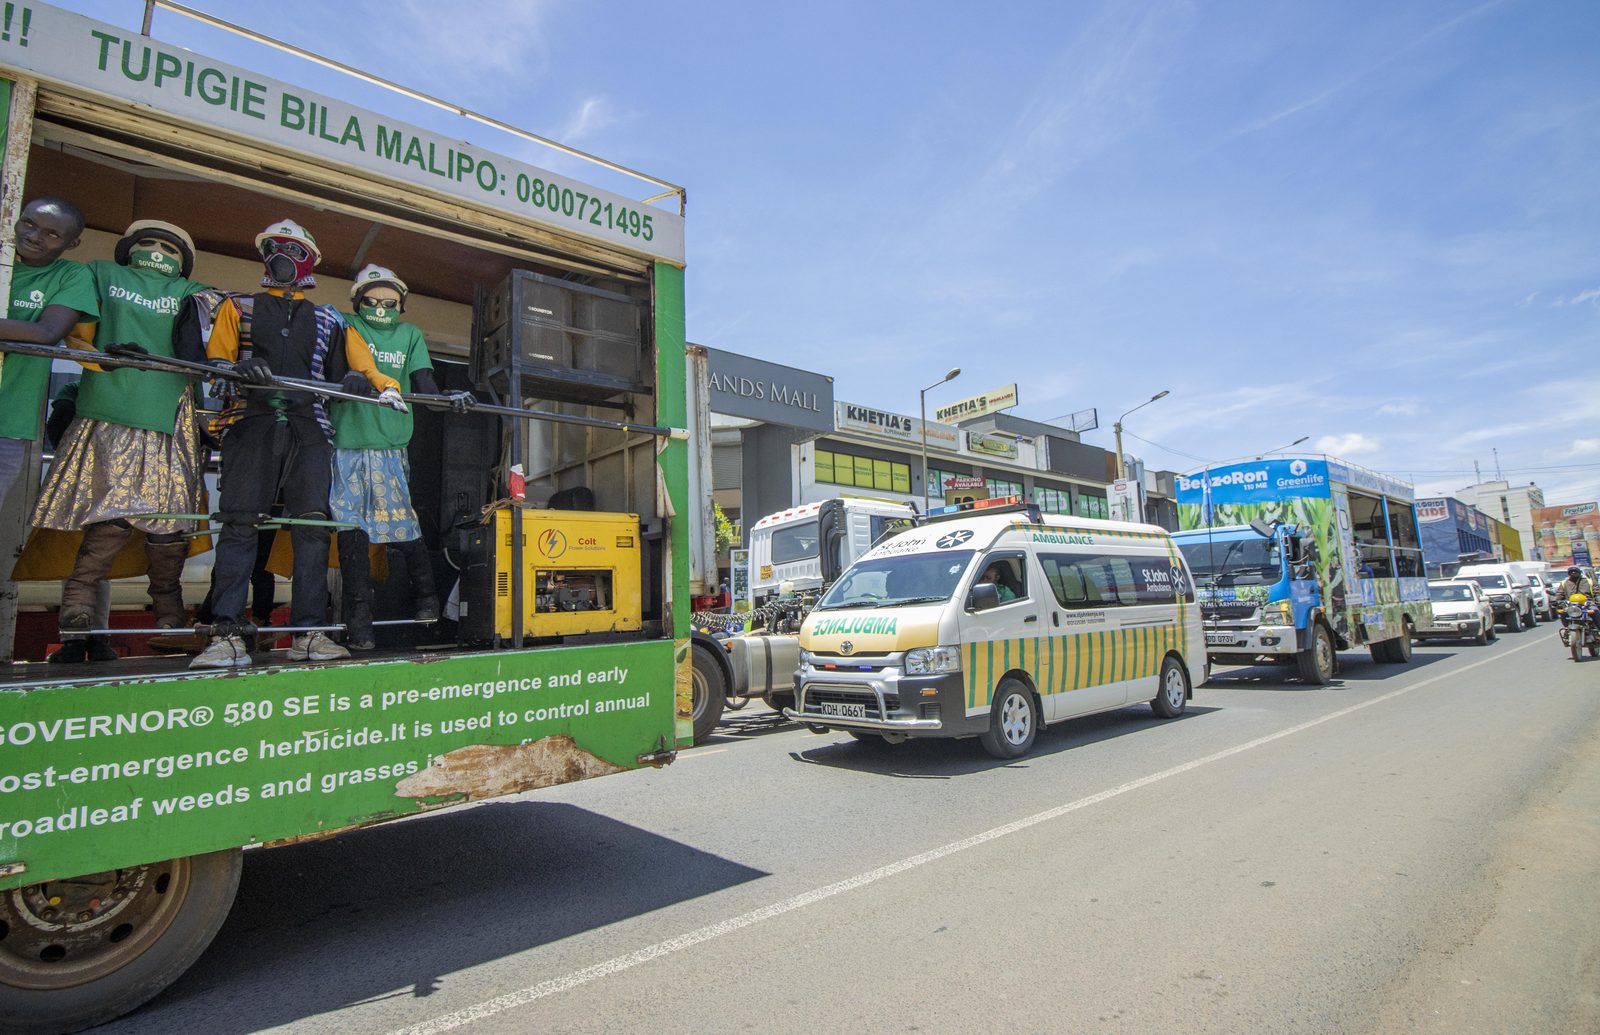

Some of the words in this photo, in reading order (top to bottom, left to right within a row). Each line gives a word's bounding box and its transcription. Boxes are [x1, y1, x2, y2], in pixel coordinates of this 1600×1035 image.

[91, 30, 268, 120] TUPIGIE
[280, 94, 365, 151] BILA
[376, 125, 507, 197] MALIPO:
[516, 173, 654, 242] 0800721495
[139, 260, 173, 272] GOVERNOR
[109, 286, 177, 311] GOVERNOR
[709, 371, 764, 399] ANDS
[770, 381, 822, 413] MALL
[847, 405, 912, 431] KHETIA'S
[936, 396, 986, 420] KHETIA'S
[1277, 474, 1324, 487] Greenlife
[1417, 506, 1447, 517] XIDE
[578, 537, 597, 546] Colt
[1033, 533, 1094, 546] AMBULANCE
[1151, 569, 1169, 582] John
[223, 700, 273, 724] 580
[283, 696, 319, 717] SE
[330, 692, 350, 712] is
[359, 693, 374, 709] a
[381, 675, 543, 714] pre-emergence
[548, 670, 582, 691] and
[587, 665, 628, 687] early
[414, 717, 433, 738] is
[441, 707, 493, 734] used
[500, 704, 518, 726] to
[524, 697, 590, 723] control
[595, 691, 650, 714] annual
[821, 703, 838, 716] KDH
[842, 704, 864, 717] 066Y
[152, 783, 248, 815] weeds
[261, 772, 311, 796] and
[320, 761, 418, 793] grasses
